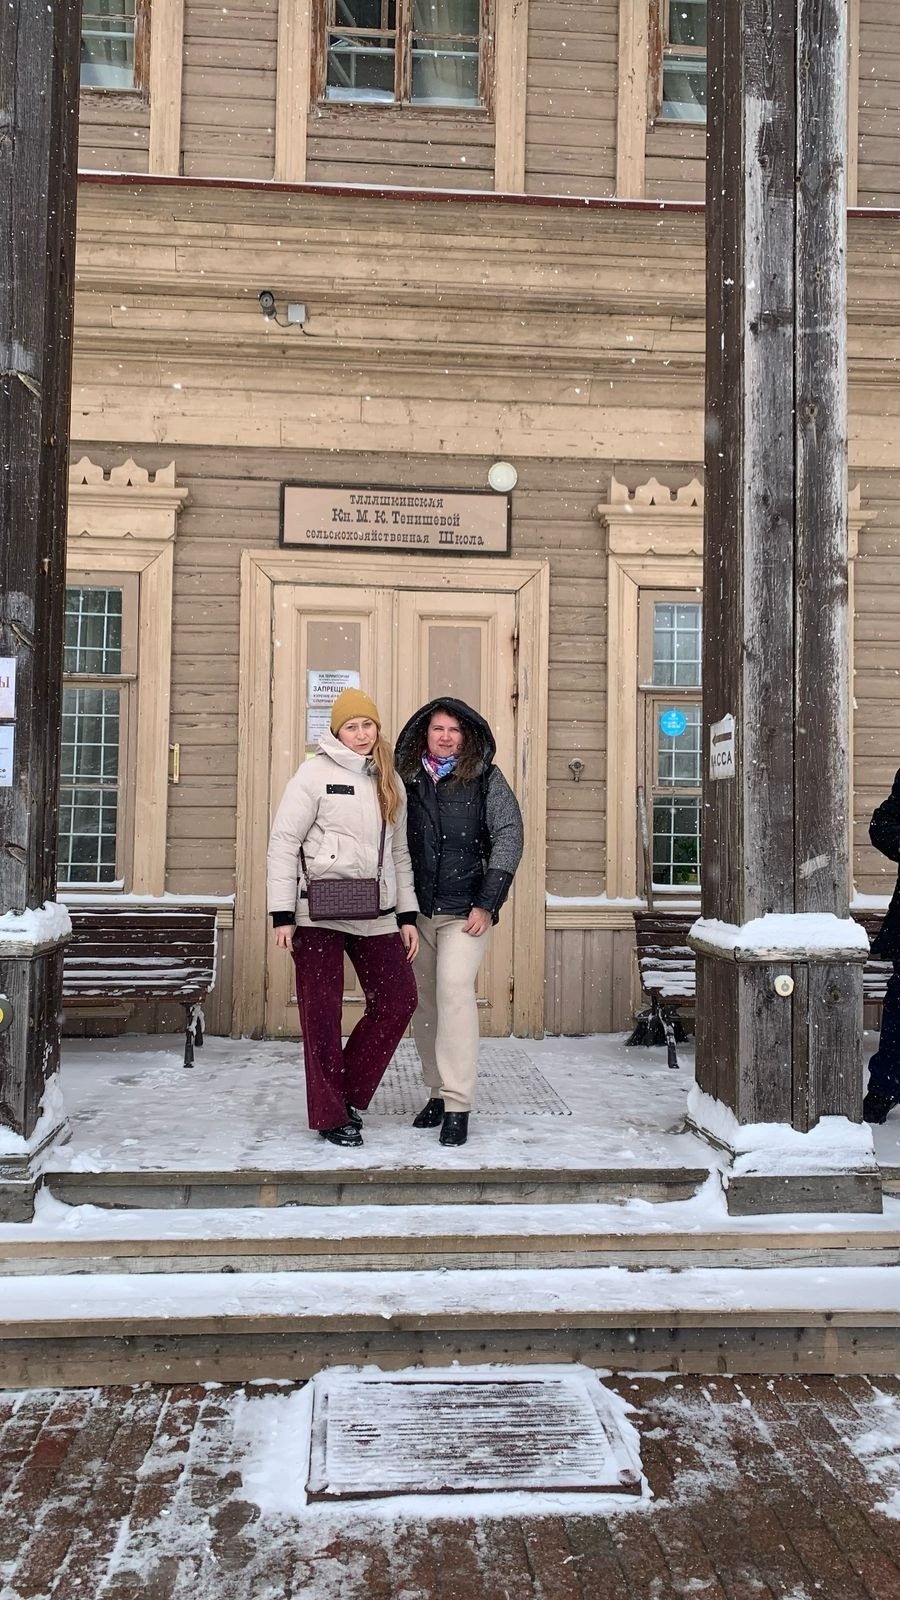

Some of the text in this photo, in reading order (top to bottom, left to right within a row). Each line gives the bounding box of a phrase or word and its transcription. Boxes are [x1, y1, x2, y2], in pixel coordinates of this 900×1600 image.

[331, 508, 461, 527] Кн. М. К. Тенишевой
[438, 531, 485, 546] Школа
